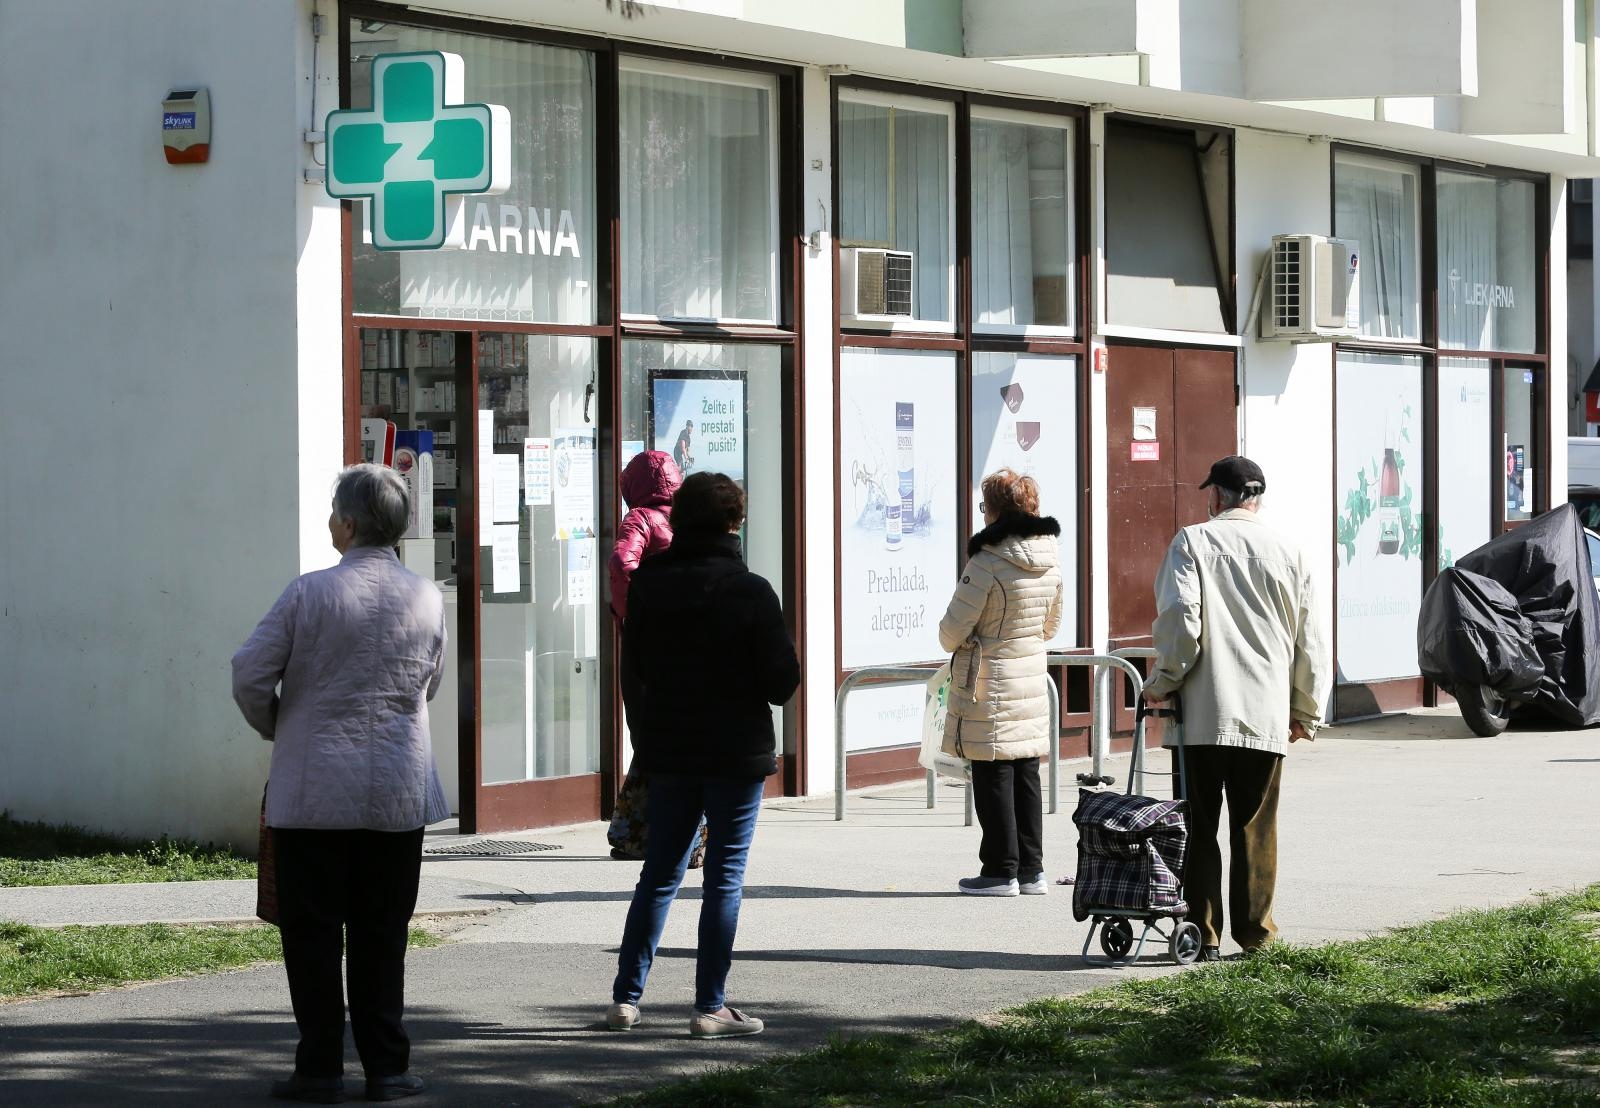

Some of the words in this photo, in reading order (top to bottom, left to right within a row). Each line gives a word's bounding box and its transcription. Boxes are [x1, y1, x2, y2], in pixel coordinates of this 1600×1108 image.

[362, 197, 581, 258] LARNA
[1465, 282, 1515, 309] LJEKARNA
[702, 397, 727, 415] Želite
[729, 399, 735, 415] li
[701, 418, 735, 436] prestati
[708, 437, 737, 455] pušiti?
[867, 566, 929, 594] Prehlada,
[871, 604, 925, 638] alergija?
